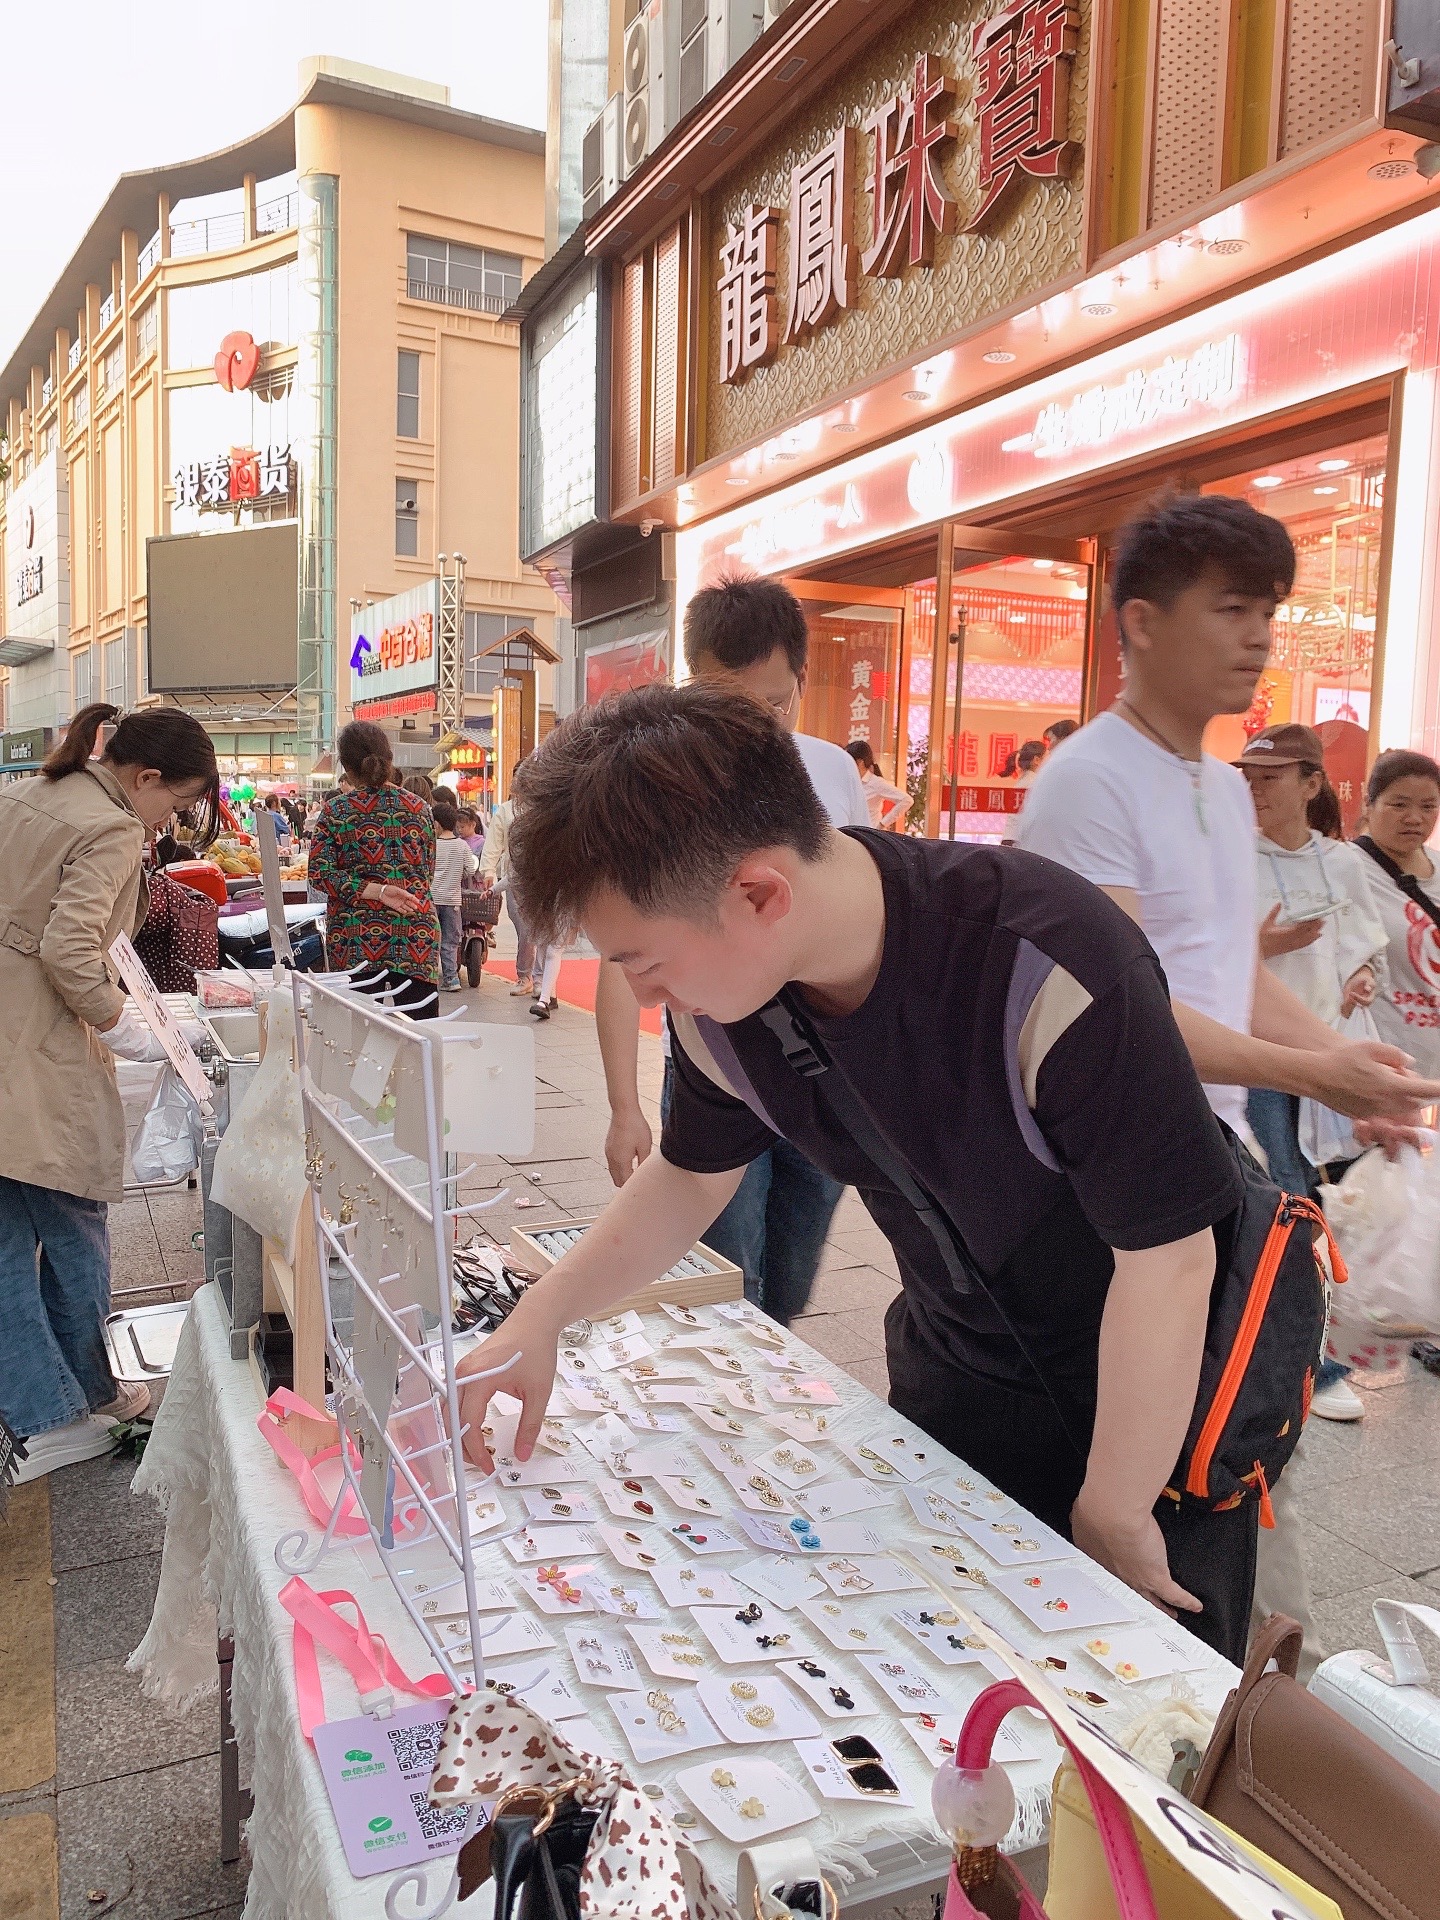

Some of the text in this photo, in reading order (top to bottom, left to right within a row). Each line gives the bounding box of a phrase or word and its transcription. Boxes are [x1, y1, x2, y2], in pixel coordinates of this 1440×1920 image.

[717, 0, 1068, 385] 龍鳳珠寶
[341, 1762, 386, 1778] 微信添加
[403, 1769, 433, 1781] 微信扫一
[363, 1831, 407, 1849] 微信支付
